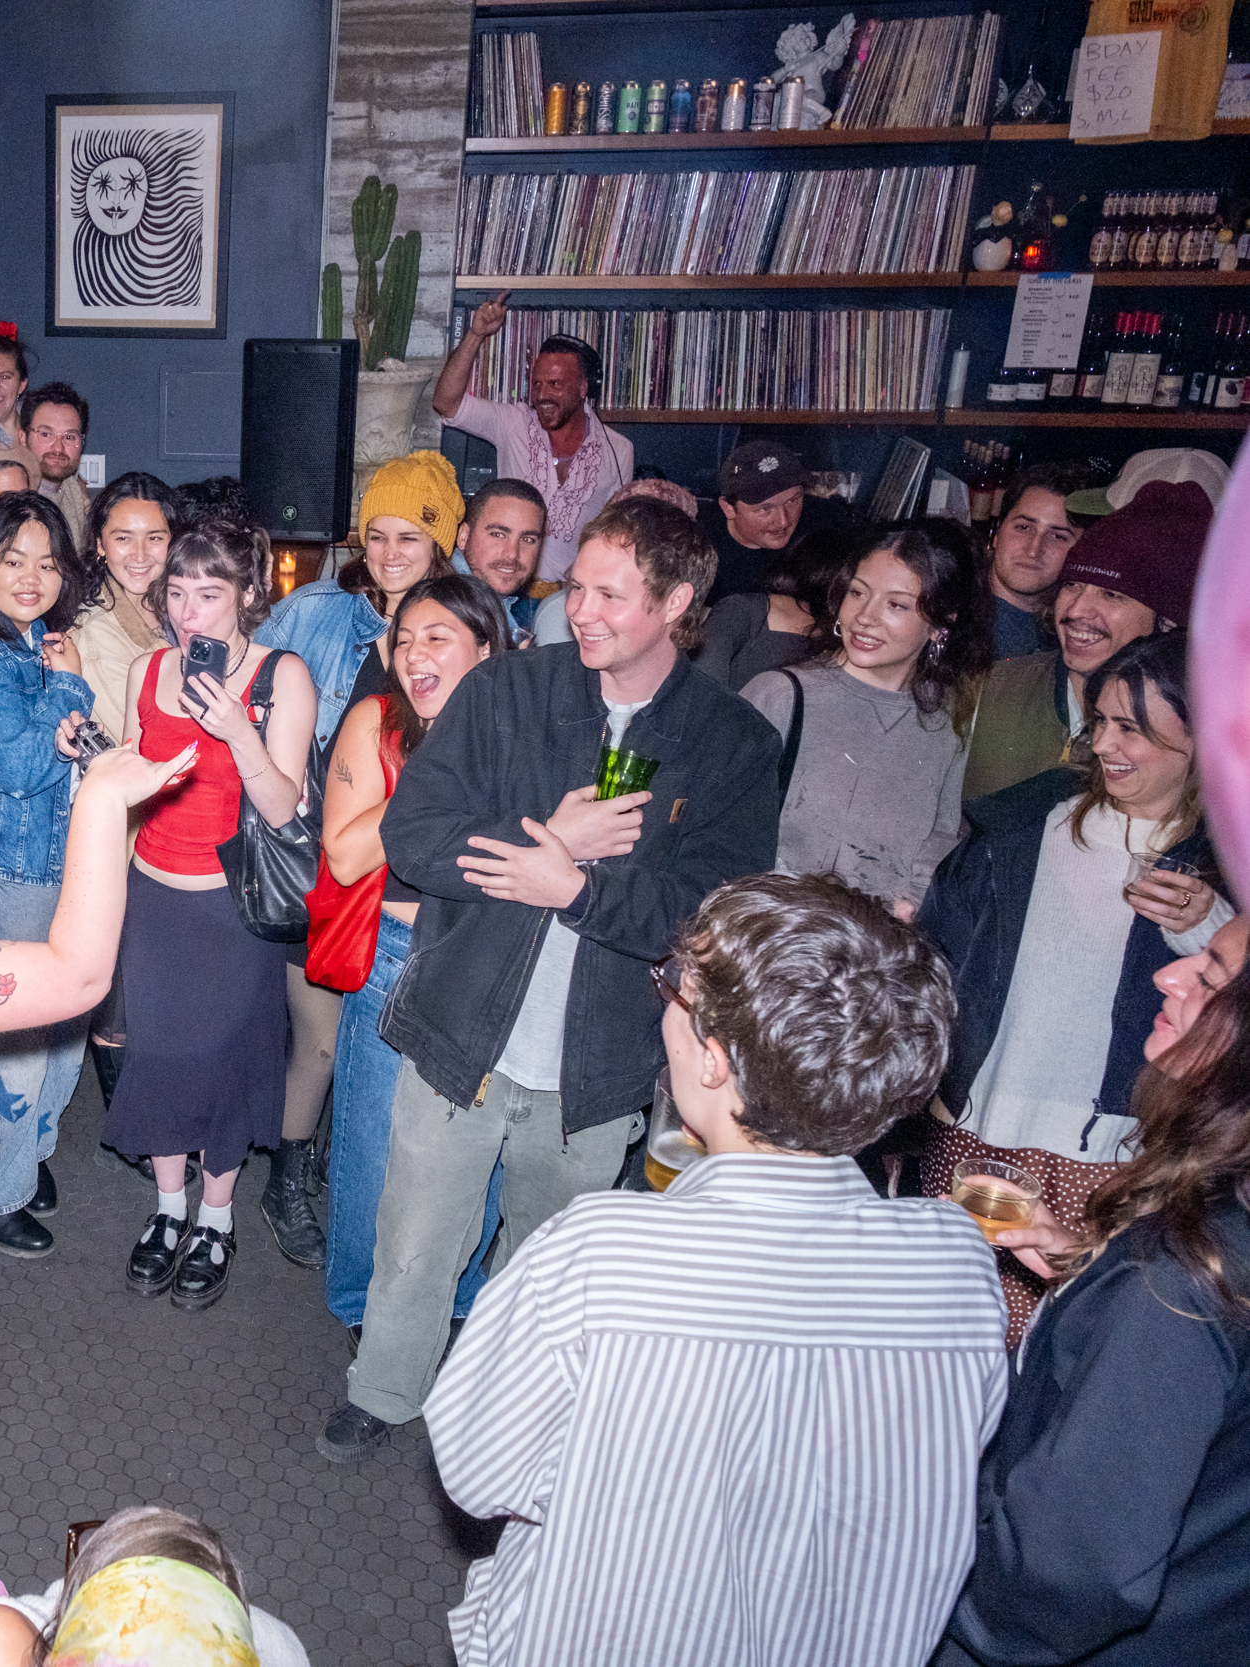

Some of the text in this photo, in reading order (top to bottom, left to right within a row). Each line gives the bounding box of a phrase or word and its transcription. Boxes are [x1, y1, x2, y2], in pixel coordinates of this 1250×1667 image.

[1086, 40, 1148, 61] BDAY
[1084, 65, 1129, 82] TEE
[1086, 85, 1132, 105] $20
[454, 316, 462, 337] DEAD
